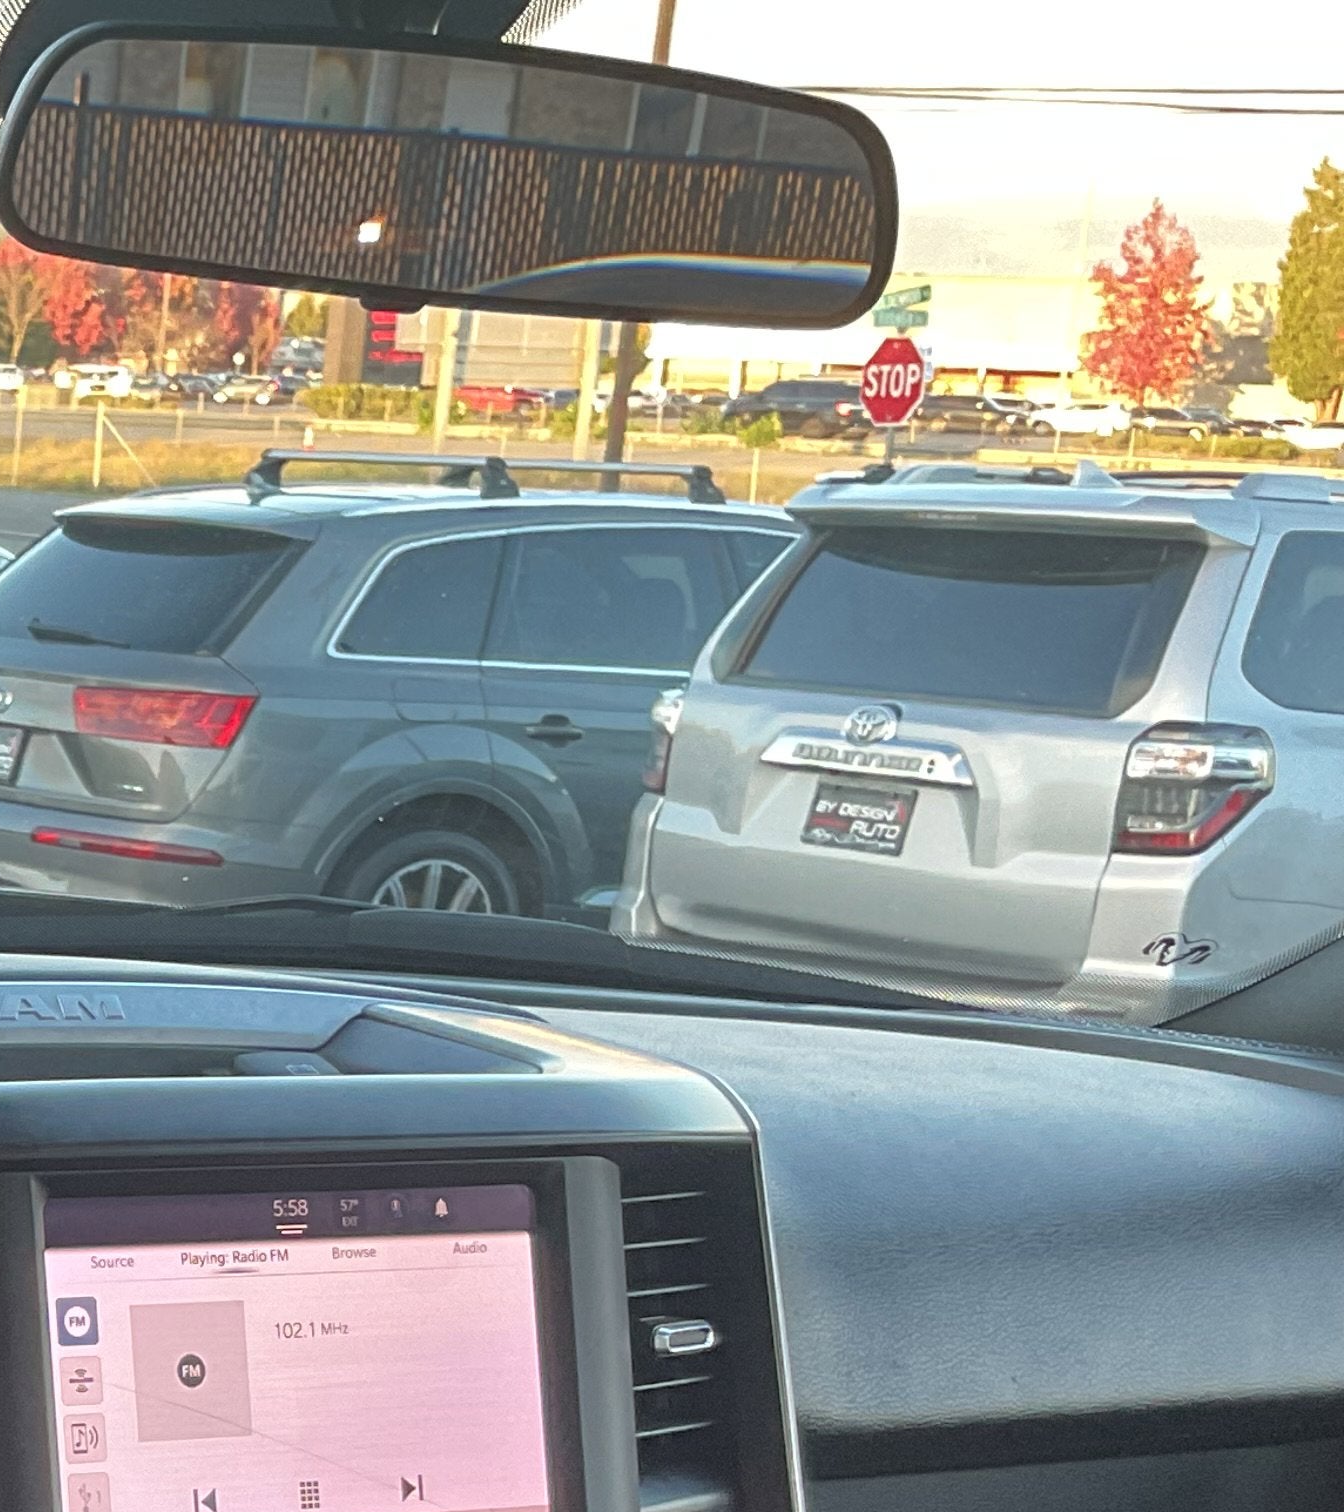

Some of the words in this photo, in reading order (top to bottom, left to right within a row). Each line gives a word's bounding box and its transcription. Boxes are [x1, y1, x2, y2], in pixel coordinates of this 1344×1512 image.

[864, 363, 921, 399] STOP
[850, 820, 901, 841] AUTO
[272, 1199, 309, 1218] 5:58
[331, 1244, 377, 1260] Browse
[452, 1241, 488, 1256] Audio
[90, 1255, 135, 1269] Source
[180, 1251, 230, 1267] Playing:
[232, 1249, 267, 1263] Radio
[270, 1248, 290, 1262] FM
[68, 1315, 86, 1328] FM
[274, 1321, 317, 1340] 102.1
[320, 1322, 350, 1336] MHz
[181, 1364, 201, 1378] FM
